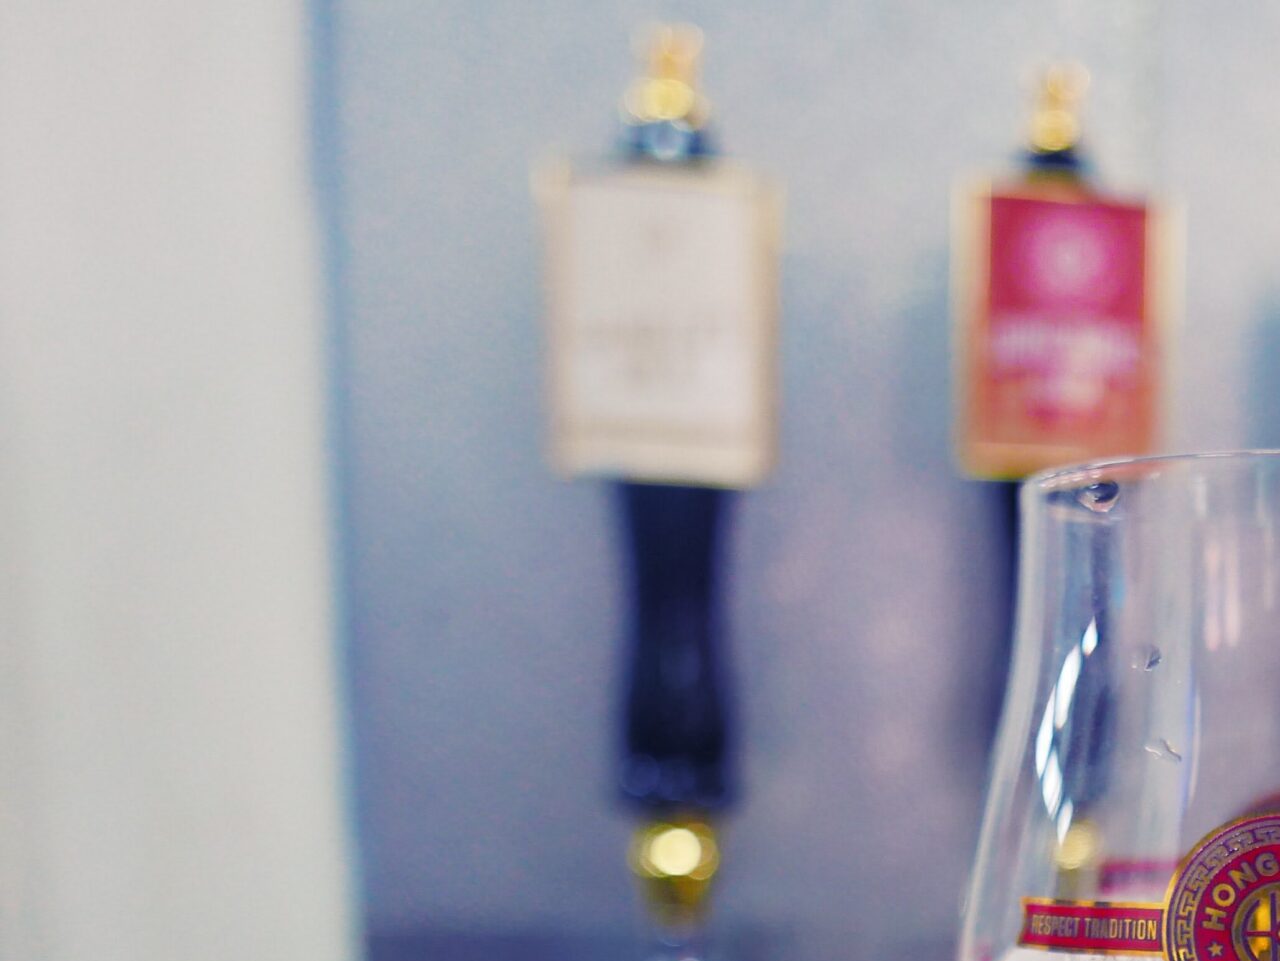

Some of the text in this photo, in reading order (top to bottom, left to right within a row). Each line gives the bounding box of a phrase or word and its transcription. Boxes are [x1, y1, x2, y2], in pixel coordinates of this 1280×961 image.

[1202, 852, 1280, 931] HONG
[1031, 914, 1157, 941] RESPECT TRADITION
